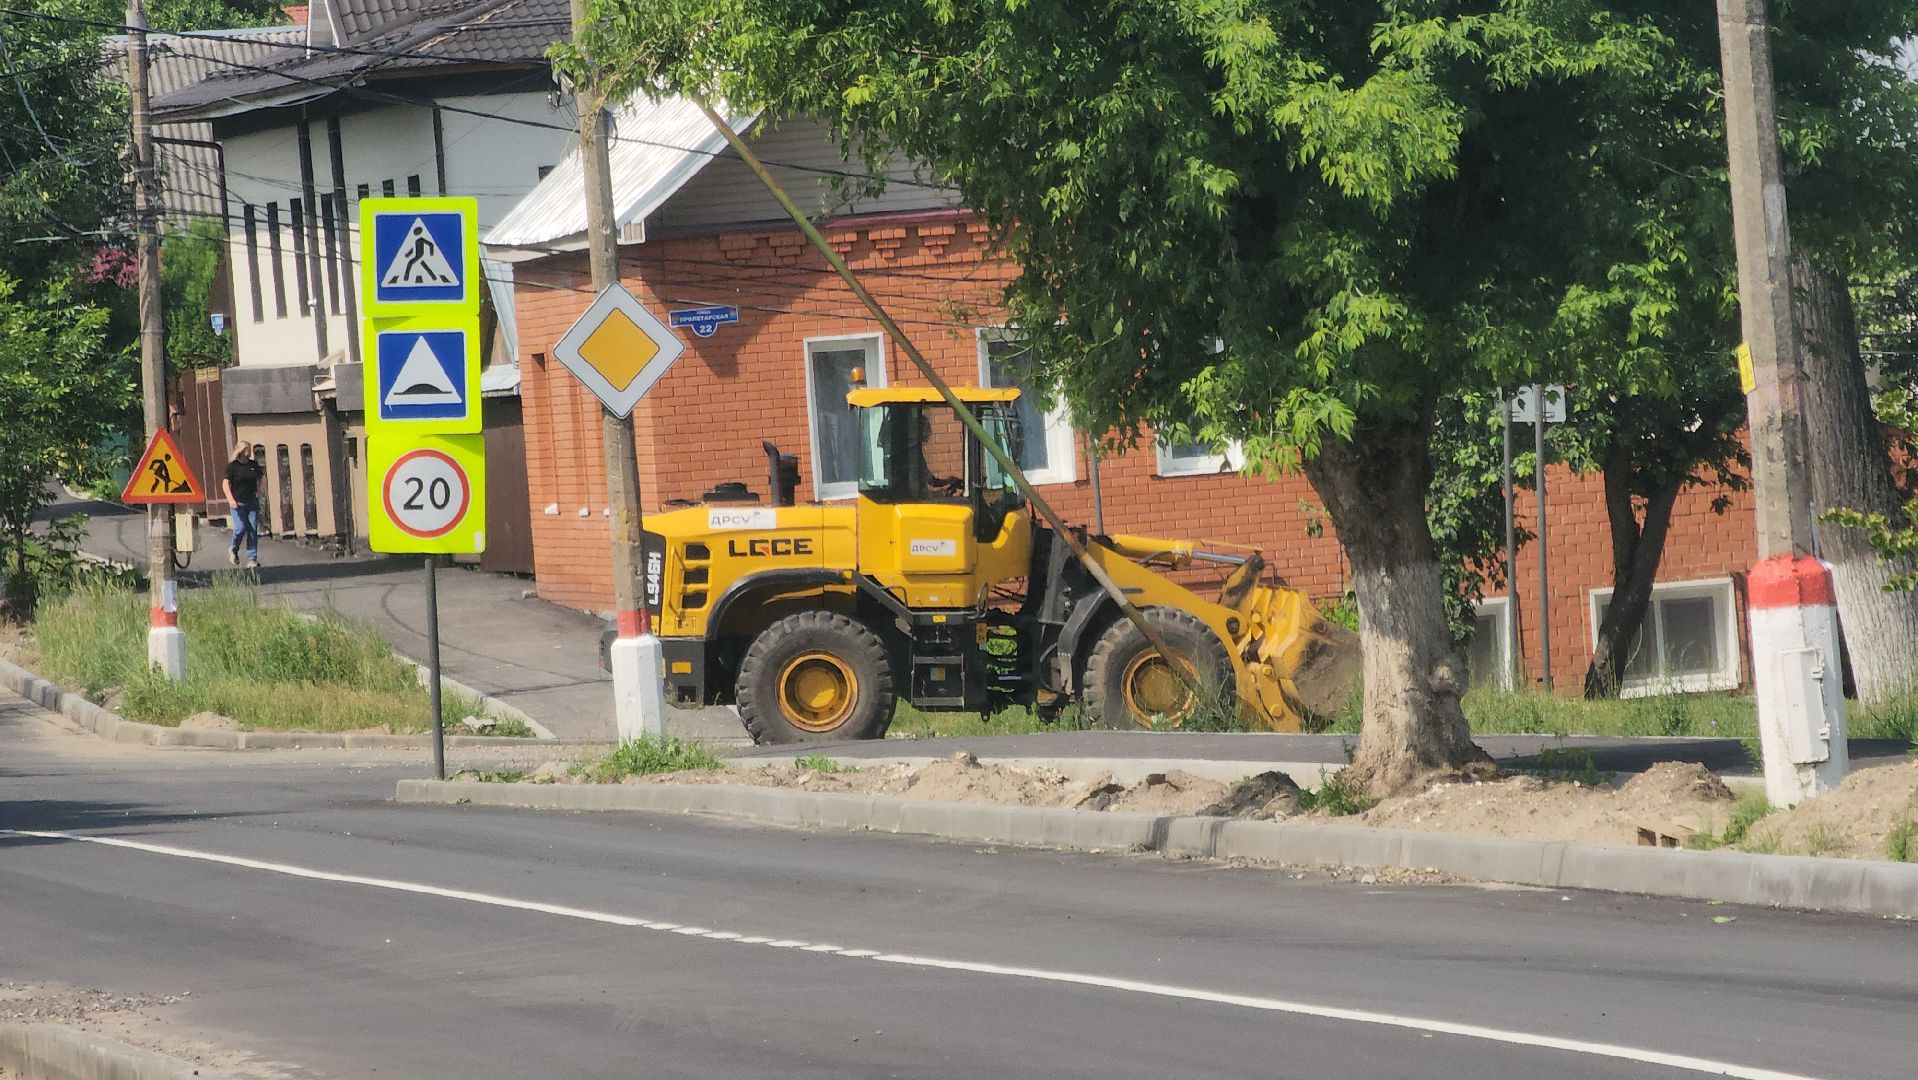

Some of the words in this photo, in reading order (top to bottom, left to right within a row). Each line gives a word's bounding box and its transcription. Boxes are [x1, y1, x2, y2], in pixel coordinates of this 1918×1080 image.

[699, 324, 713, 334] 22
[403, 477, 451, 511] 20
[711, 515, 751, 526] ДРСУ
[911, 544, 940, 553] ДРСУ
